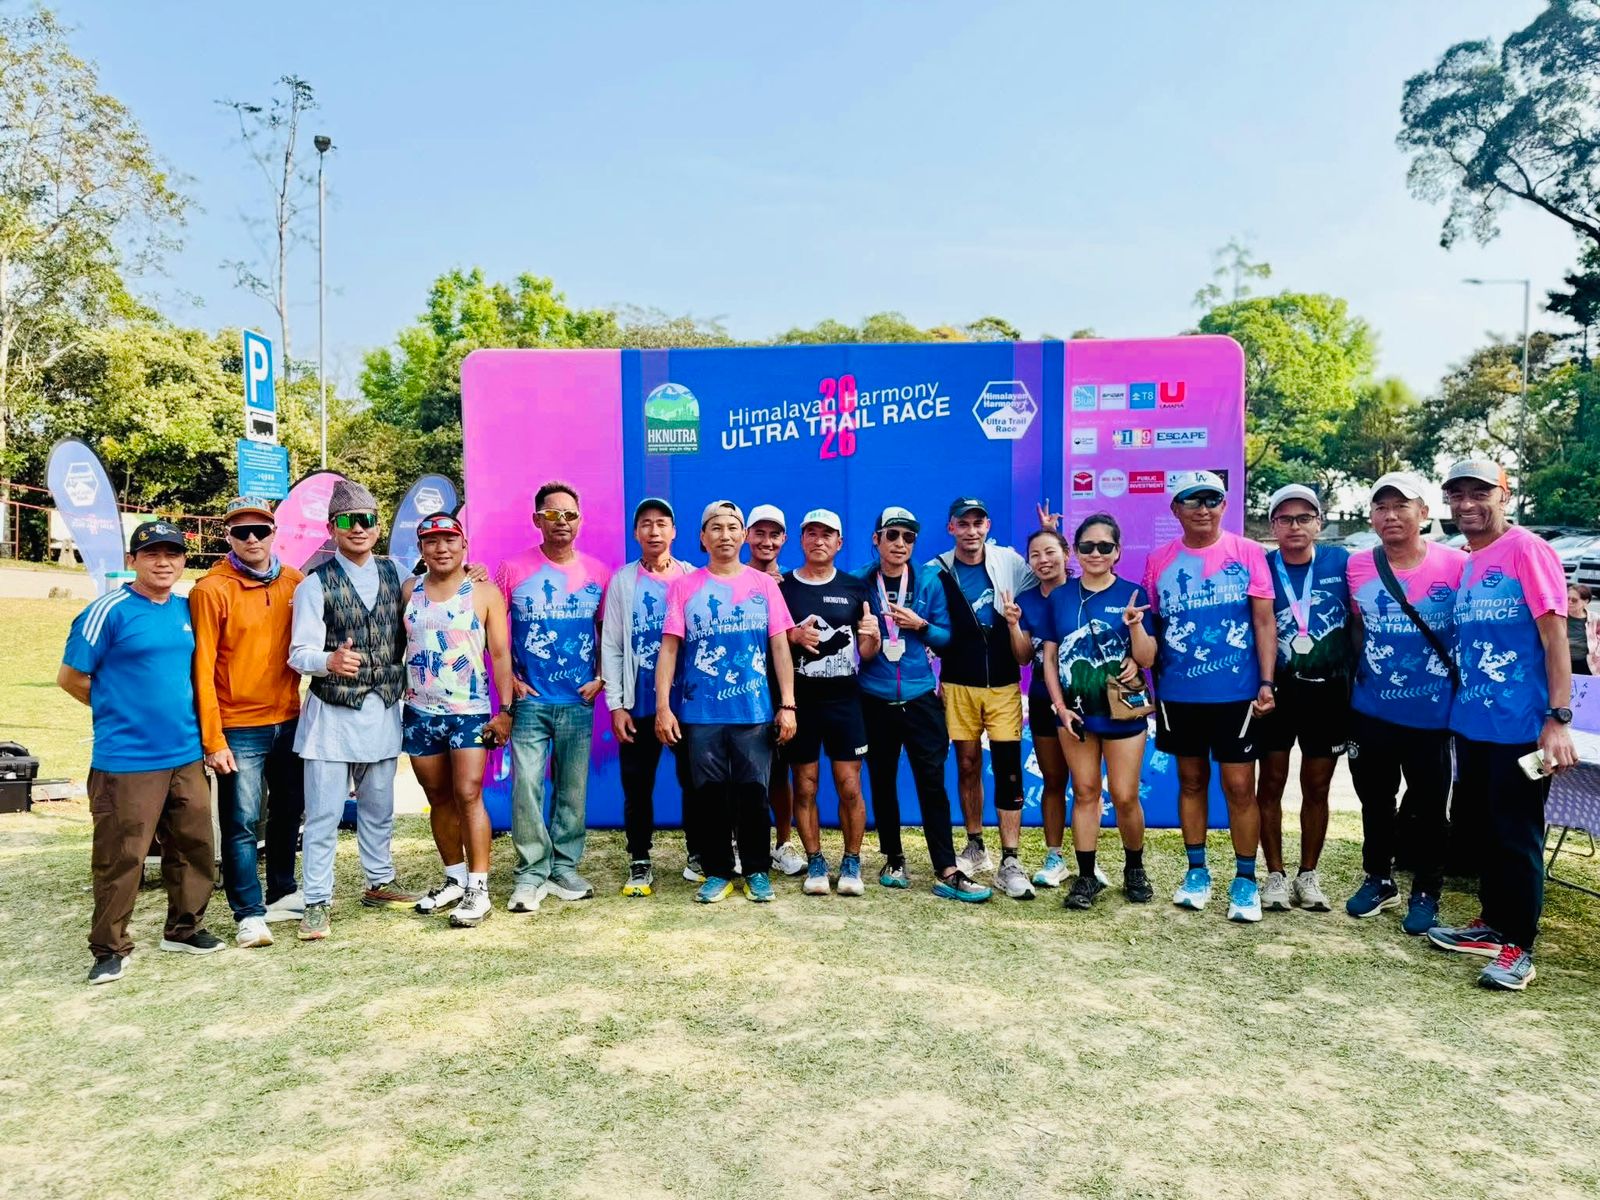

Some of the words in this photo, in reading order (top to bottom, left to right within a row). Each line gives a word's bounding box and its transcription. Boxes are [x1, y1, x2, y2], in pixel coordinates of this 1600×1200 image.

[248, 338, 269, 403] P
[983, 392, 1029, 400] Himalayan
[1141, 391, 1154, 401] T8
[728, 397, 836, 428] Himalayan
[844, 382, 939, 409] Harmony
[983, 401, 1026, 411] Harmony
[721, 420, 800, 450] ULTRA
[804, 408, 876, 437] TRAIL
[882, 396, 951, 425] RACE
[986, 417, 1007, 425] Ultra
[1008, 417, 1027, 425] Trail
[647, 428, 698, 443] HKNUTRA
[1156, 431, 1206, 441] ESCAPE
[1187, 595, 1222, 610] TRAIL
[1470, 597, 1520, 608] armony
[550, 609, 582, 620] TRAIL
[1475, 606, 1520, 620] RACE
[717, 621, 749, 635] TRAIL
